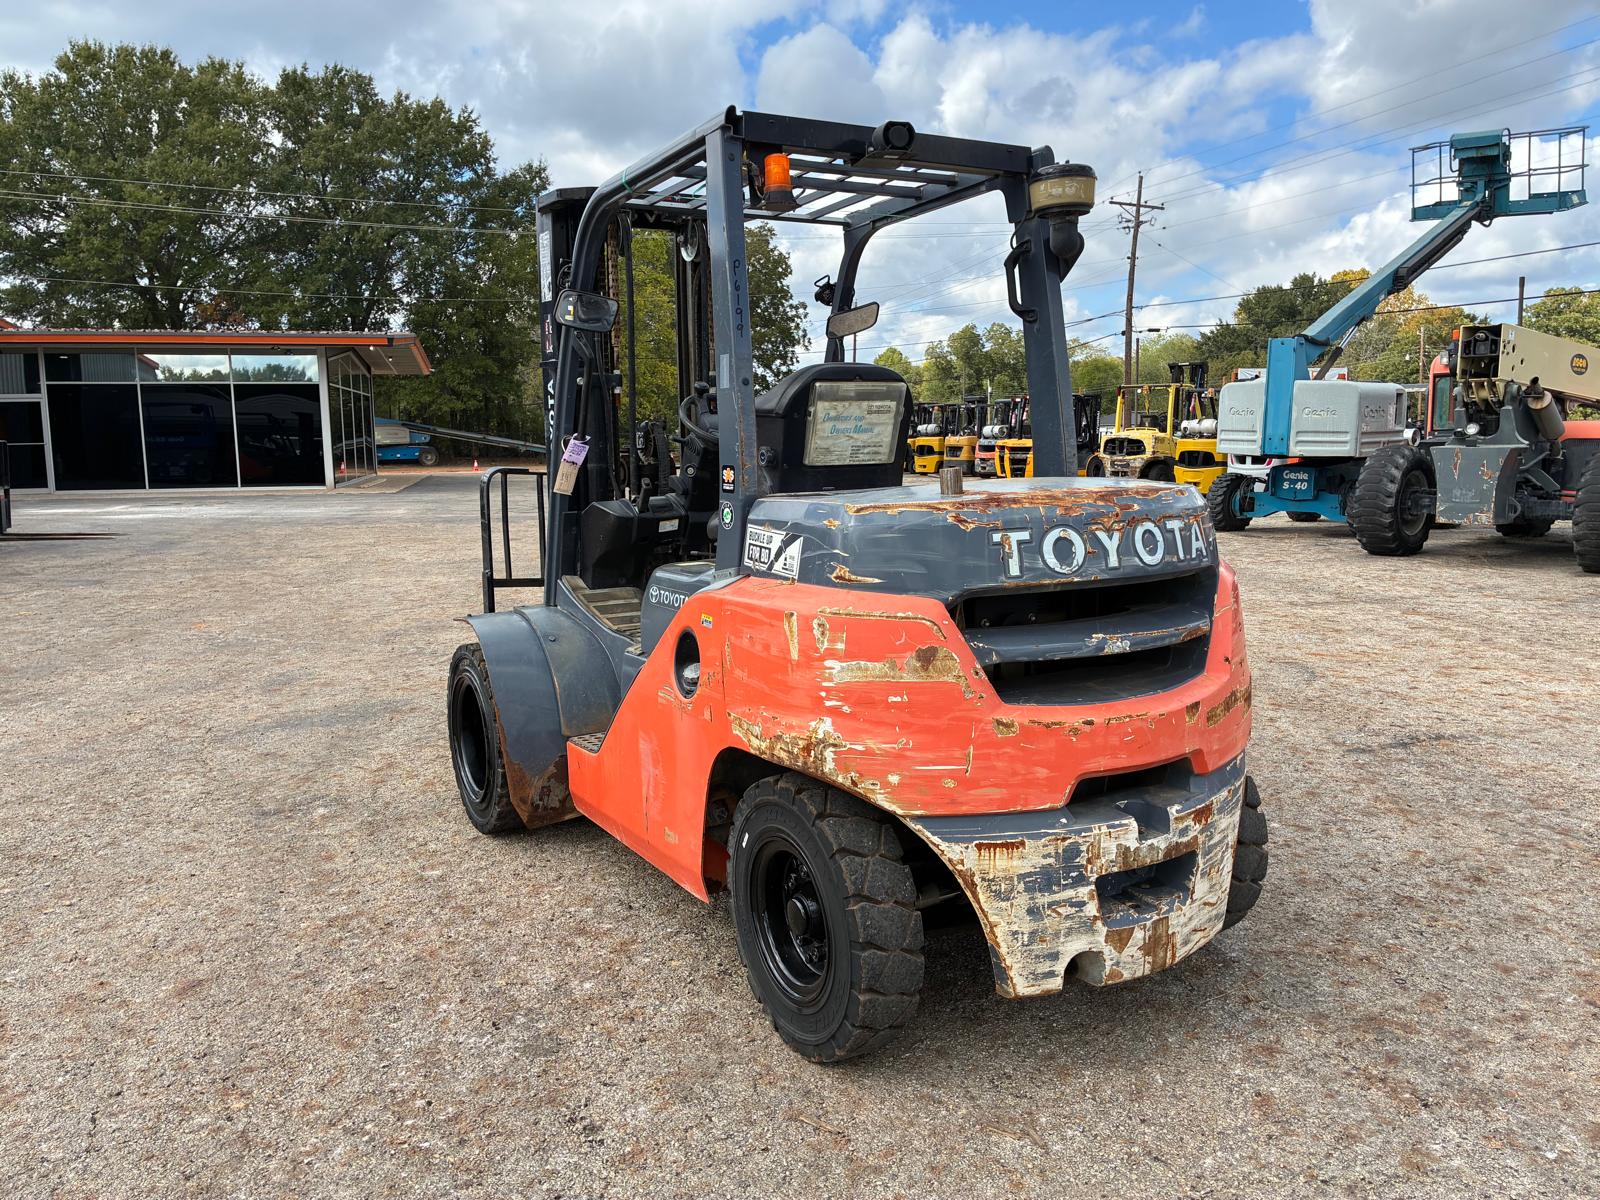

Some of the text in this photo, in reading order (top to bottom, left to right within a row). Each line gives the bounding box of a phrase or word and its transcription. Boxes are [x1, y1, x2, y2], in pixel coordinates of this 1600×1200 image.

[733, 259, 744, 338] P6199
[1229, 406, 1255, 416] Genie
[1302, 406, 1338, 417] Genie
[1363, 405, 1386, 418] Genie
[1283, 470, 1308, 480] Genie
[748, 530, 774, 545] BUCKLE UP
[749, 545, 761, 561] FOR
[992, 520, 1207, 577] TOYOTA
